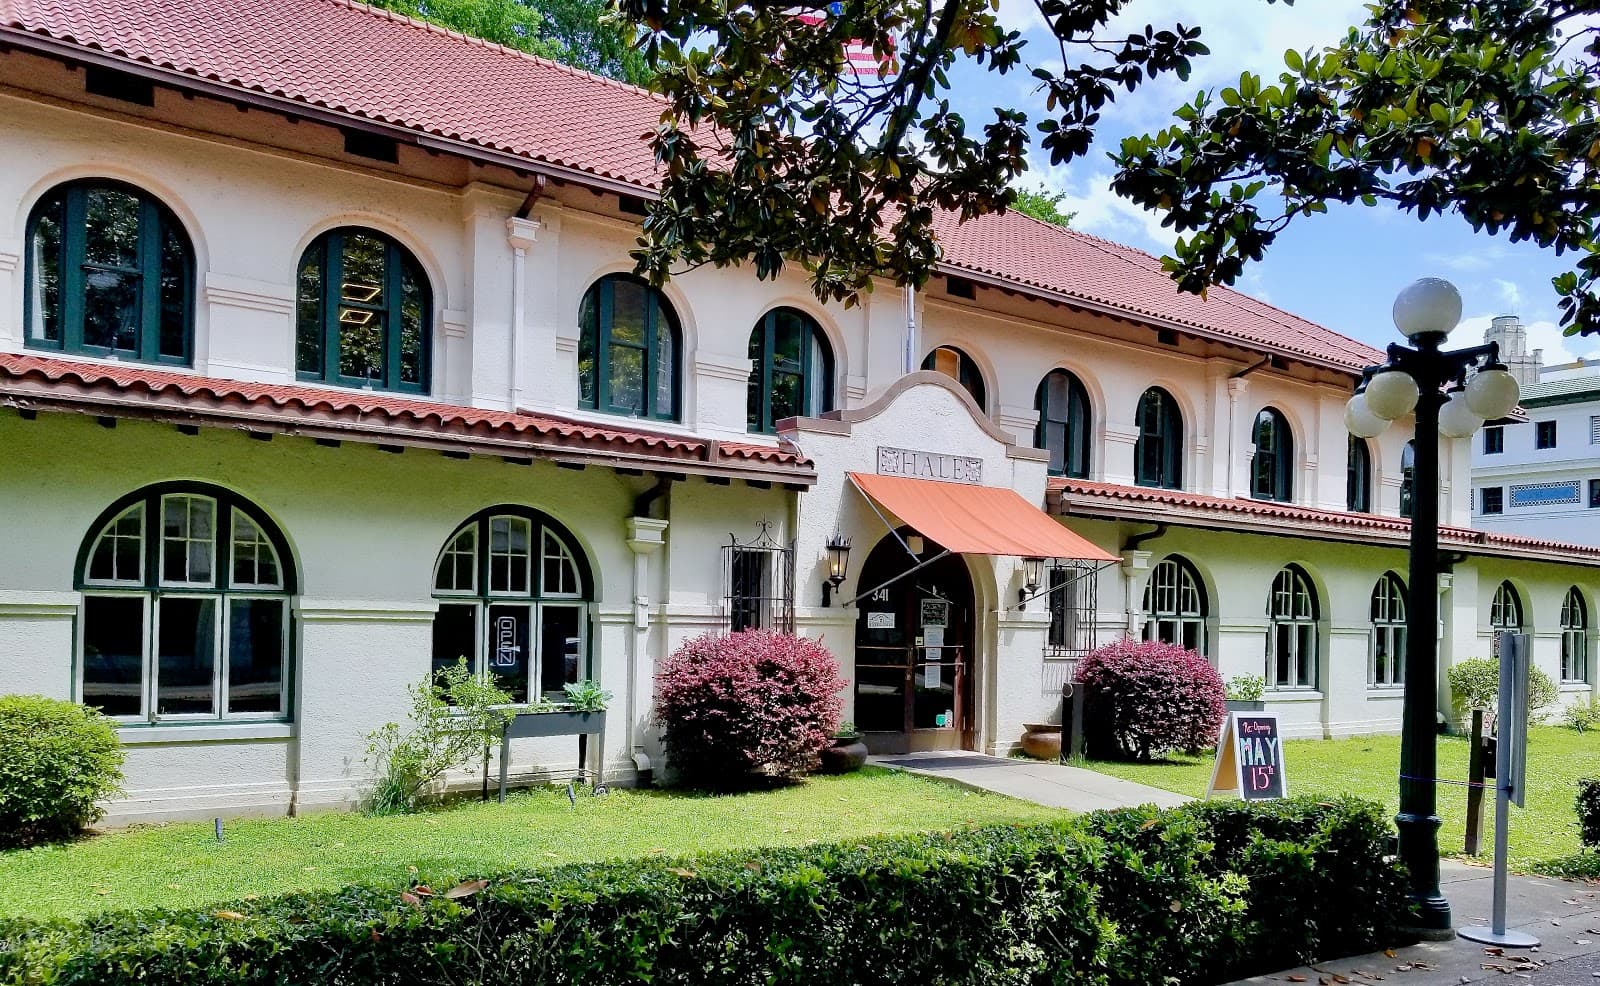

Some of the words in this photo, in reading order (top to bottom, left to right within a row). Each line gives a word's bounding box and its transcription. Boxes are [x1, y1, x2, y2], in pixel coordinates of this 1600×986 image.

[902, 452, 964, 480] HALE
[872, 588, 889, 602] 341
[500, 620, 513, 664] OPEN
[1239, 737, 1278, 766] MAY
